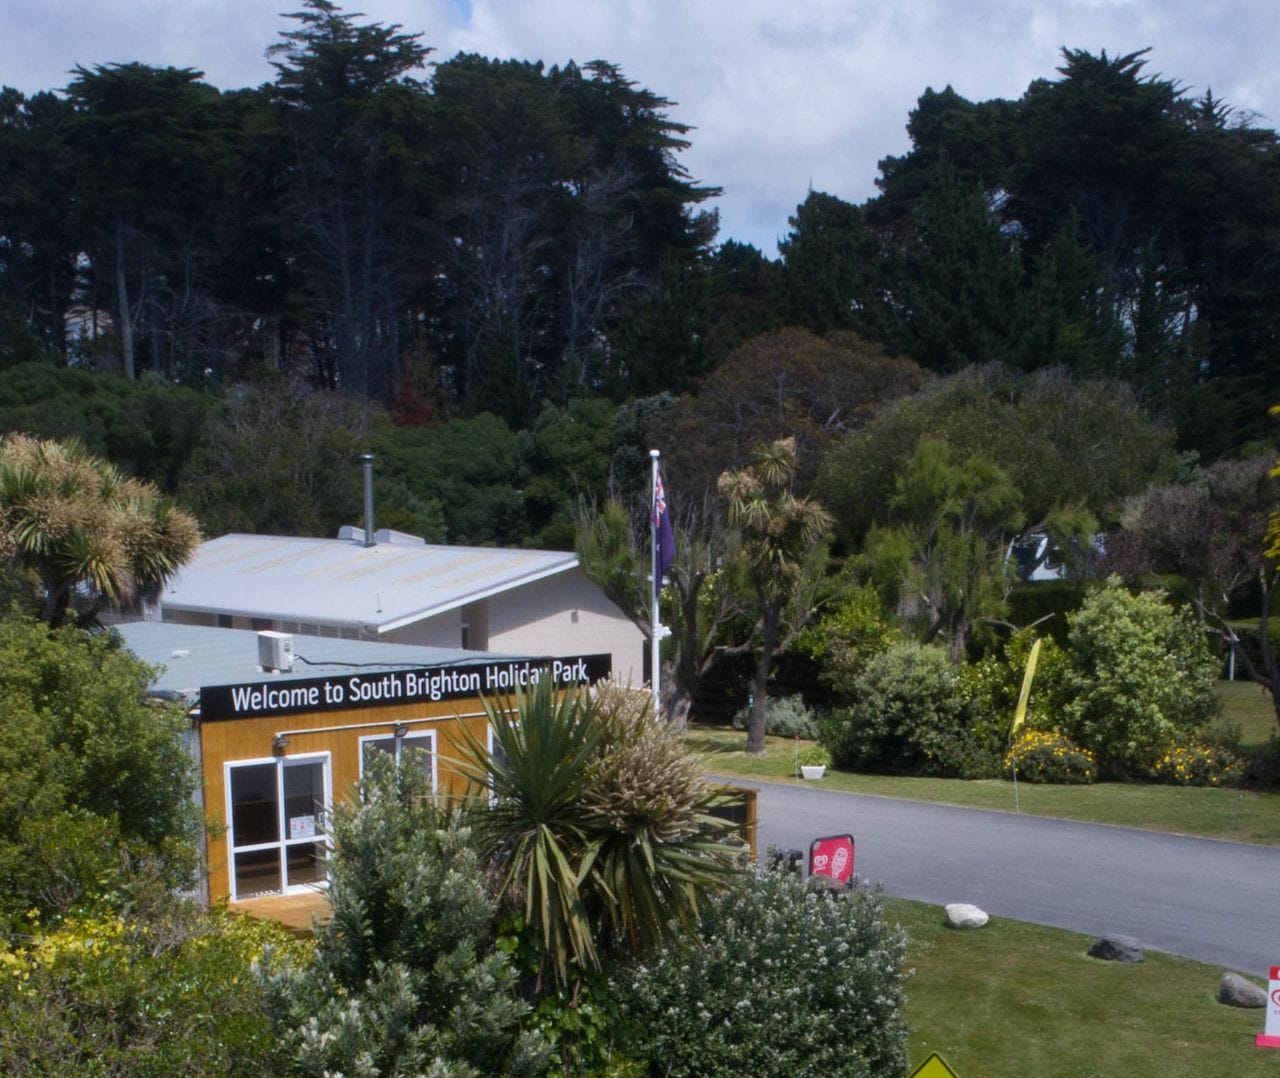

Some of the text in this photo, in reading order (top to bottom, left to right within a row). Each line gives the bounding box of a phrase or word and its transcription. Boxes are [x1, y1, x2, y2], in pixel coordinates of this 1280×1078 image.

[231, 684, 319, 712] Welcome
[324, 681, 344, 703] to
[349, 674, 402, 701] South
[406, 669, 480, 700] Brighton
[553, 658, 588, 683] Park
